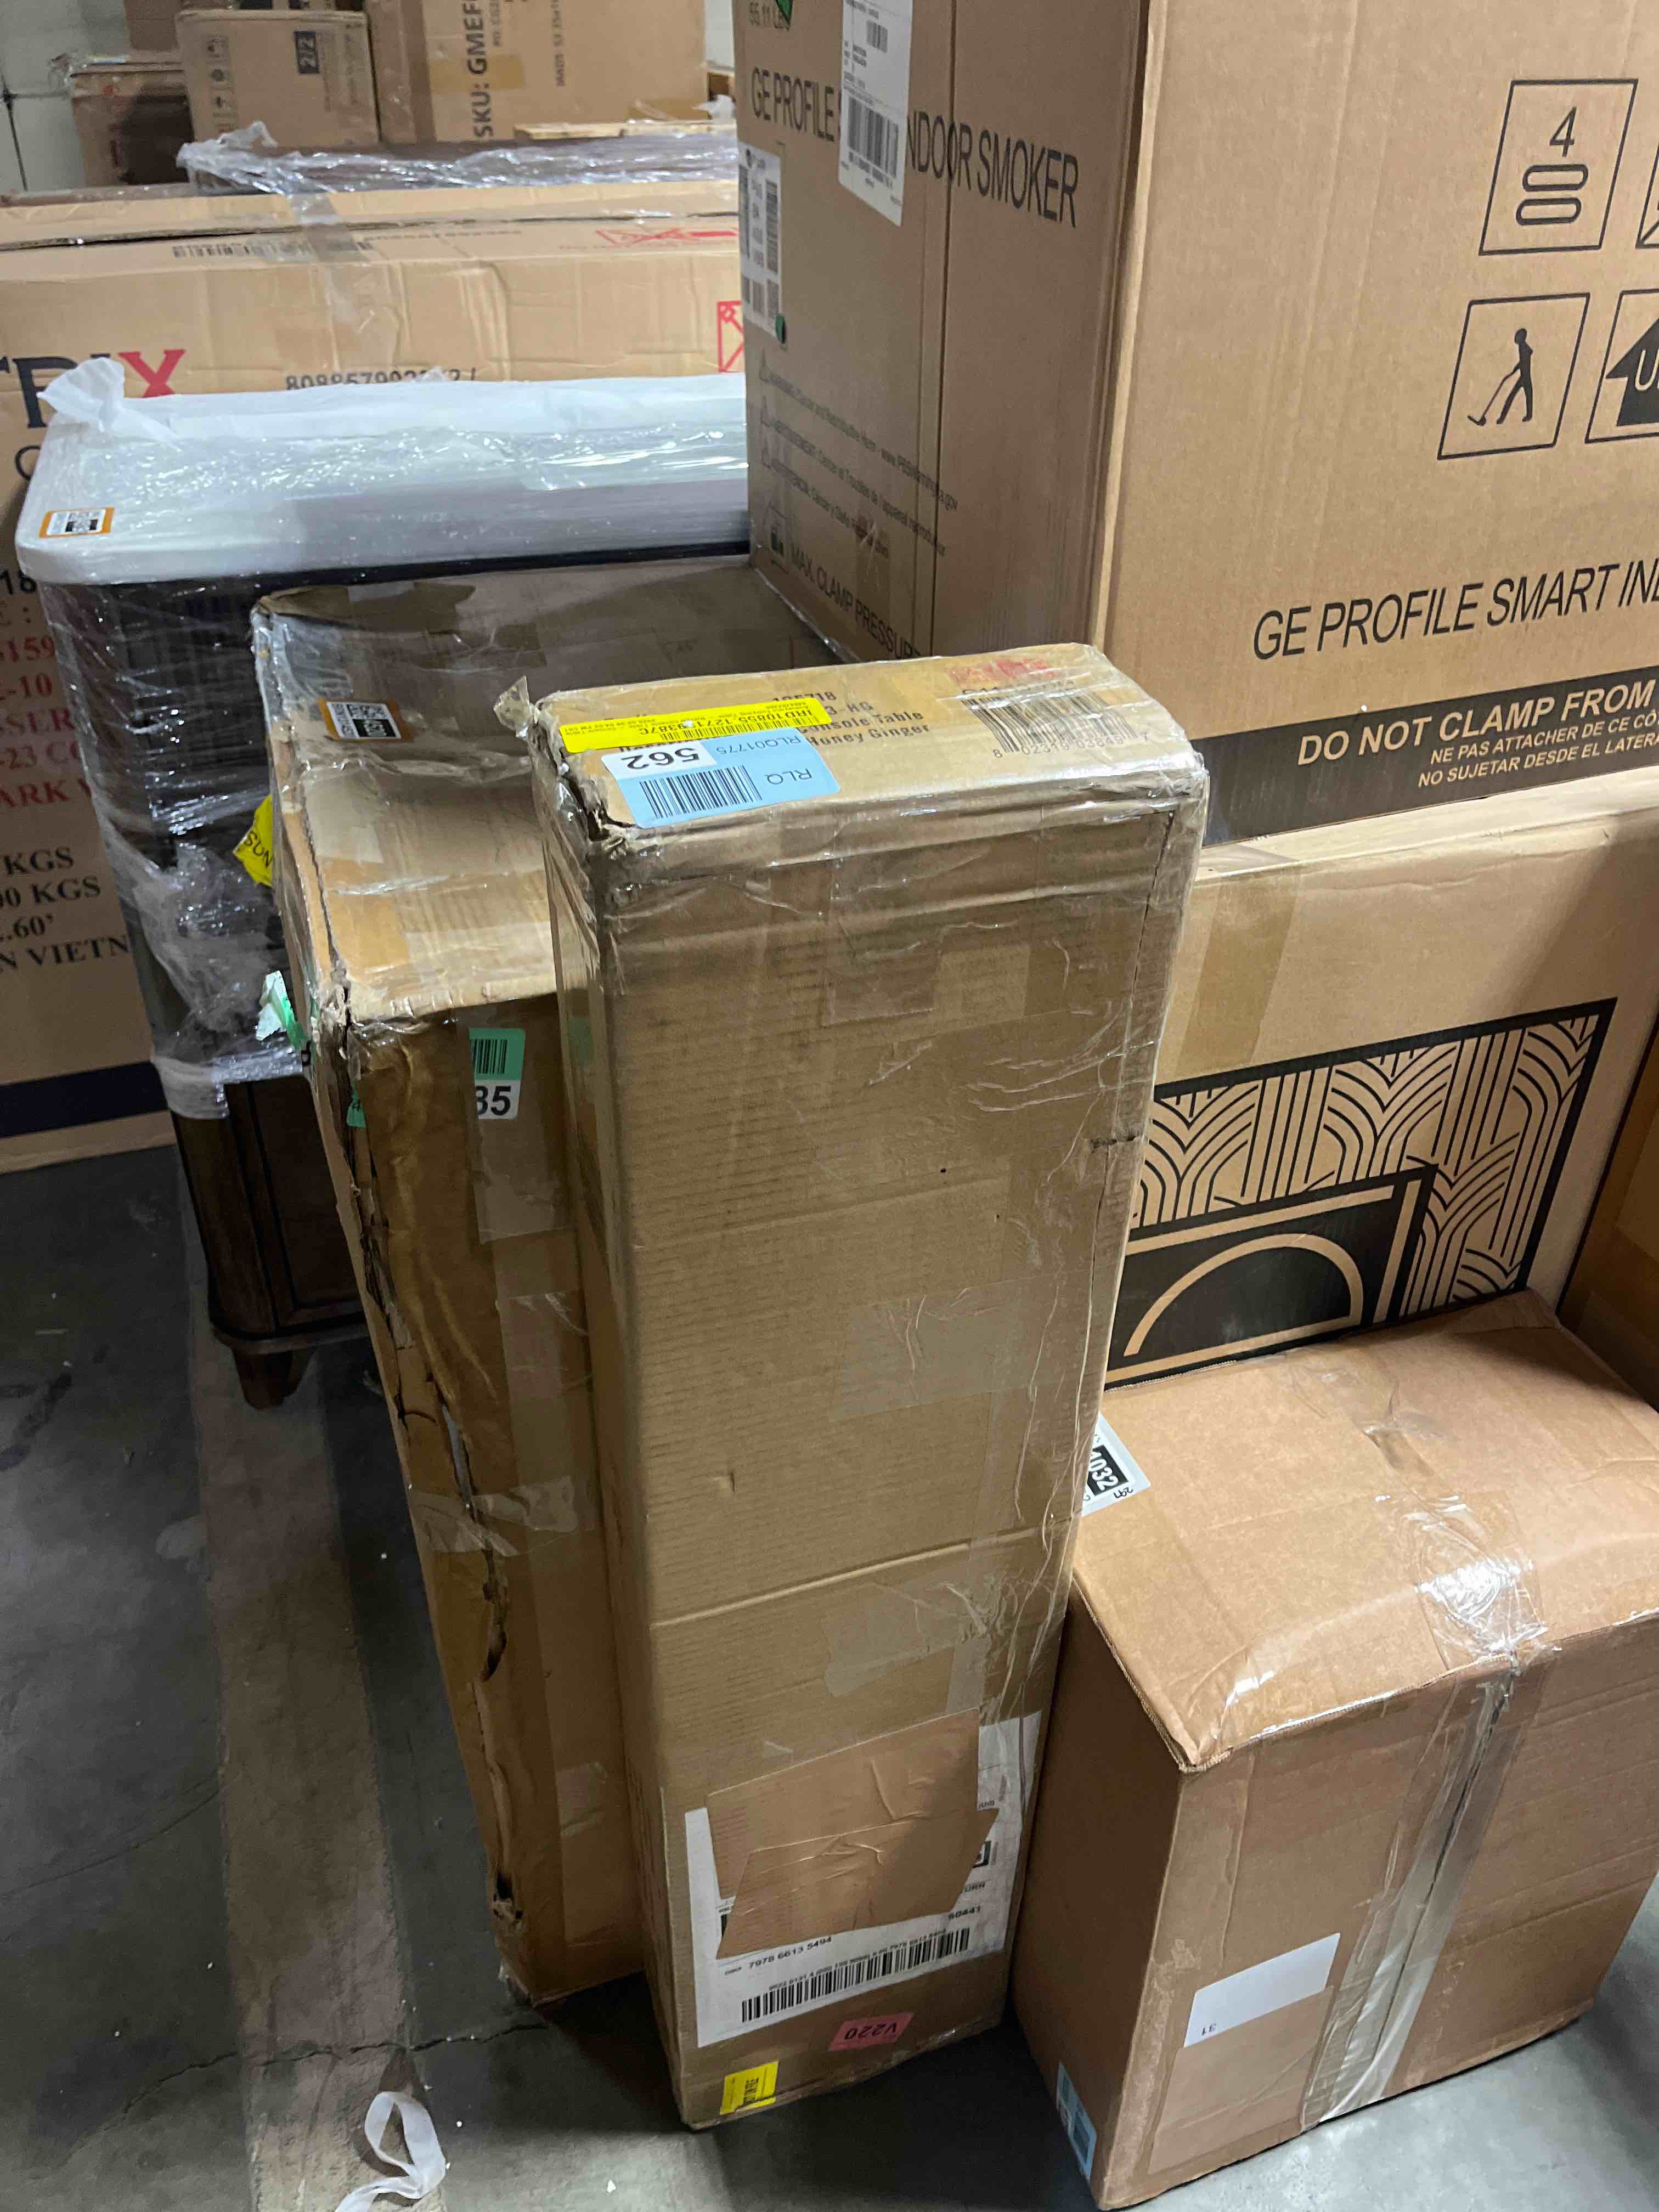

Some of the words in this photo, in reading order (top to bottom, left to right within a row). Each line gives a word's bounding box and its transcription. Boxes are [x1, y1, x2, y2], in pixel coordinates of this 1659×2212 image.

[462, 0, 487, 75] GMEF
[471, 83, 493, 138] SKU:
[752, 67, 770, 121] GE
[774, 72, 834, 142] PROFILE
[977, 129, 1079, 229] SMOKER
[1549, 106, 1577, 157] 4
[1635, 348, 1659, 392] U
[1253, 606, 1312, 661] GE
[1317, 582, 1484, 652] PROFILE
[1487, 563, 1621, 627] SMART
[867, 724, 932, 740] Ginger
[872, 711, 924, 724] Table
[1297, 730, 1350, 766] DO
[1358, 716, 1433, 755] NOT
[1438, 696, 1555, 742] CLAMP
[1561, 679, 1657, 722] FROM
[716, 735, 802, 755] RLQ01775
[992, 749, 1003, 759] 8
[1430, 747, 1454, 765] NE
[1457, 740, 1490, 760] PAS
[1492, 725, 1579, 756] ATTACHER
[1581, 720, 1605, 739] DE
[1607, 716, 1630, 733] CE
[1633, 709, 1659, 730] CÔ
[620, 747, 701, 770] 562
[766, 768, 814, 785] RLQ
[1417, 770, 1443, 789] NO
[1446, 757, 1521, 783] SUJETAR
[1523, 746, 1580, 768] DESDE
[1581, 742, 1601, 759] EL
[4, 847, 74, 876] KGS
[31, 875, 101, 904] KGS
[749, 1956, 775, 1968] 7978
[777, 1946, 804, 1960] 6613
[807, 1936, 832, 1949] 5494
